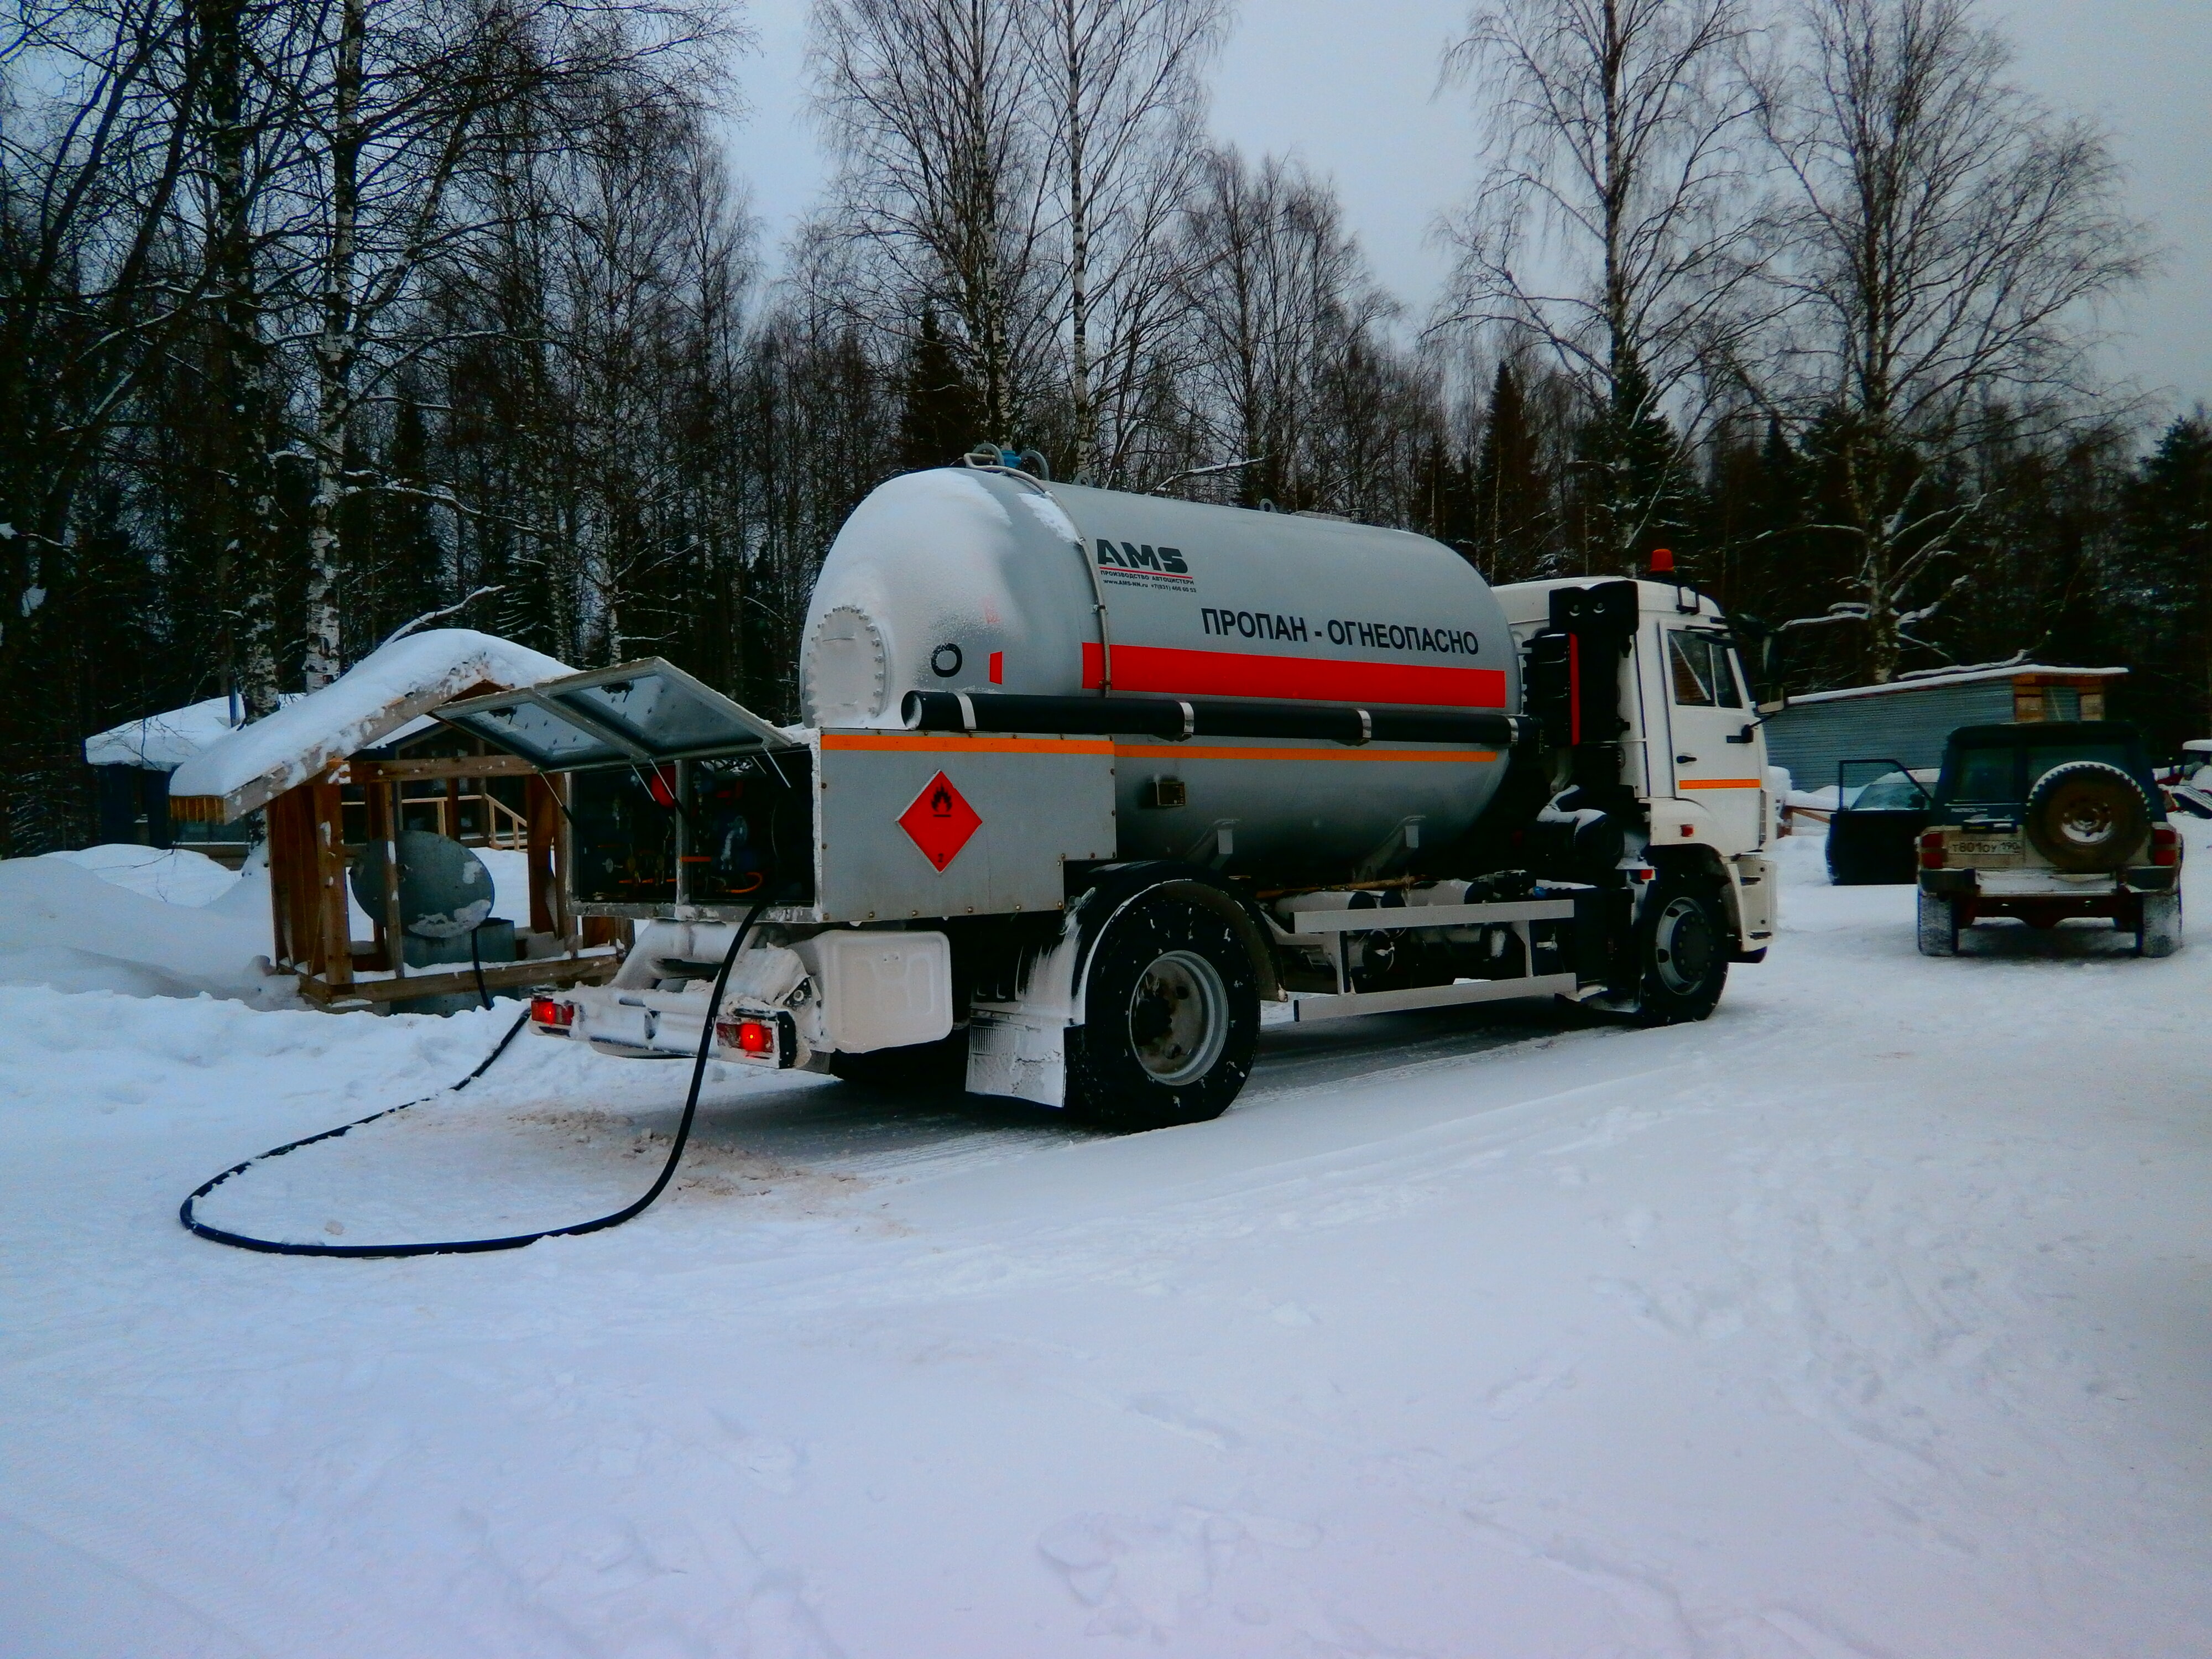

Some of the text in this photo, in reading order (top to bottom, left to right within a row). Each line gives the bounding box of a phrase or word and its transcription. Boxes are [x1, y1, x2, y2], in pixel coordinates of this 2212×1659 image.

[1097, 539, 1188, 573] AMS
[1100, 570, 1194, 585] ПРОИЗВОДСТВО АВТОЦИСТЕРН
[1201, 608, 1308, 642] ПРОПАН
[1327, 619, 1479, 655] ОГНЕОПАСНО
